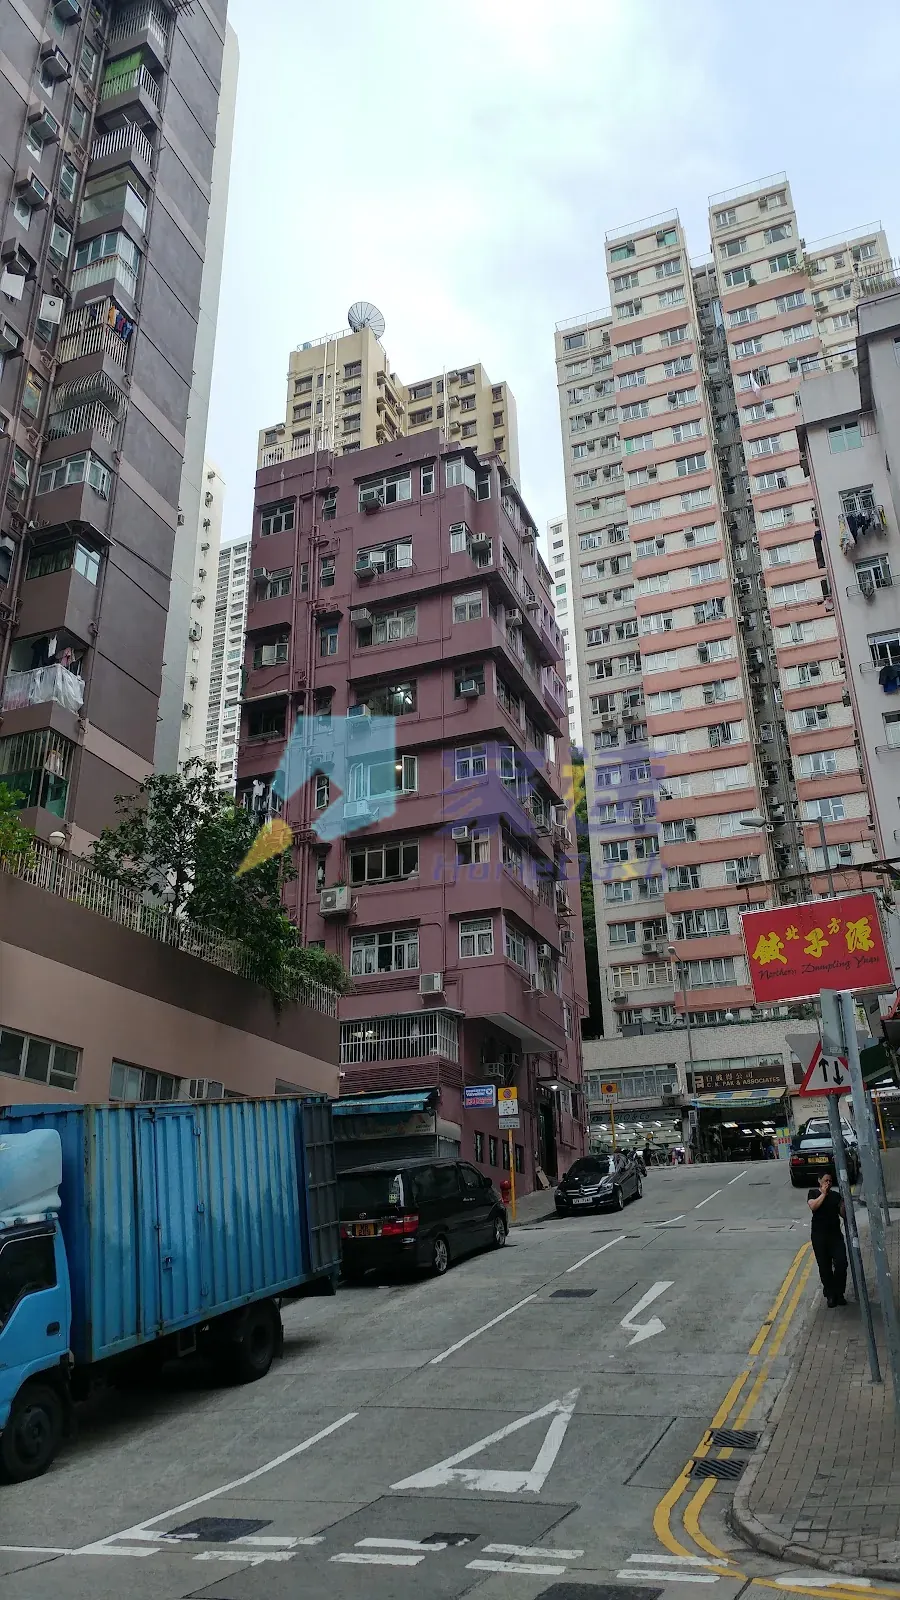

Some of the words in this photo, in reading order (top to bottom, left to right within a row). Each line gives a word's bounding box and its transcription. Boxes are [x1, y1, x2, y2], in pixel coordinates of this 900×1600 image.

[758, 968, 797, 981] Northern
[801, 961, 851, 974] Dumpling
[853, 955, 881, 968] Yuan
[742, 1076, 781, 1085] ASSOCIATES
